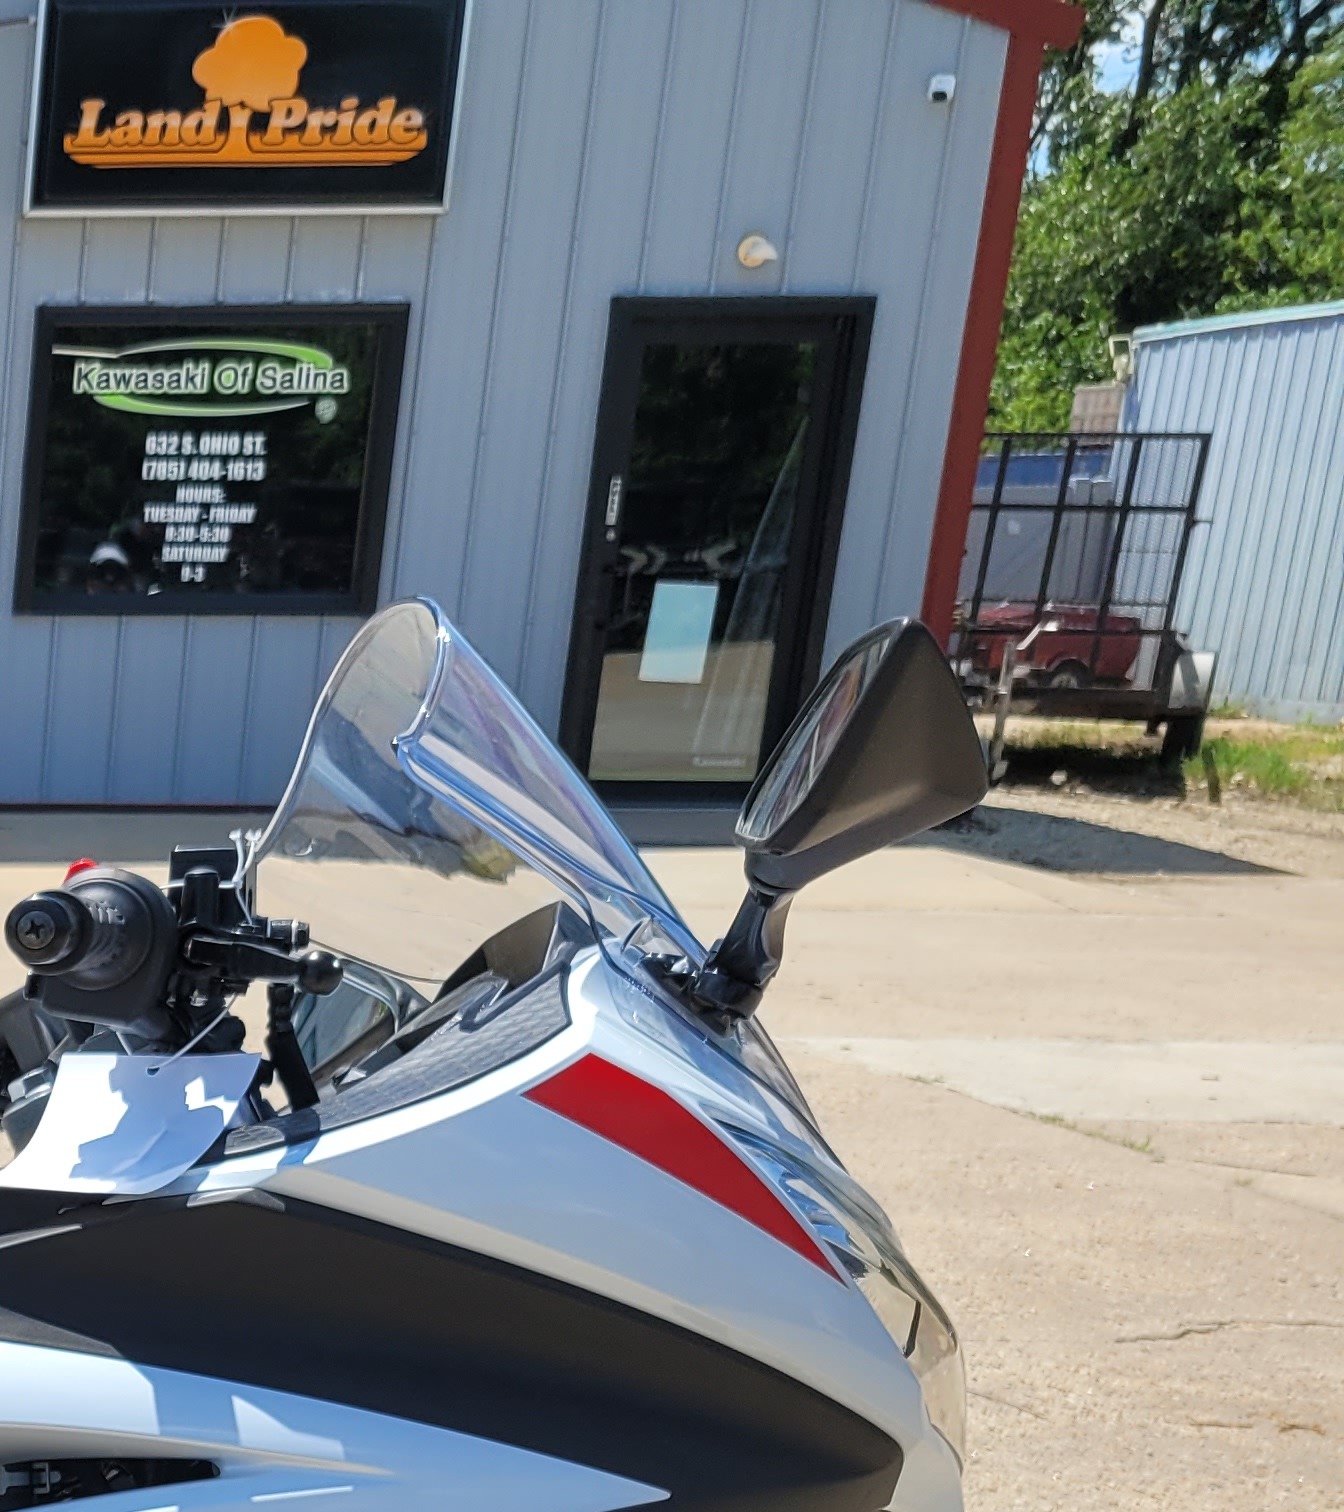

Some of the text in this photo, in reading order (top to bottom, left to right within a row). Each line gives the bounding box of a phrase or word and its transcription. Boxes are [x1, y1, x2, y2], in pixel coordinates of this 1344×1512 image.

[73, 96, 423, 148] Land Pride
[75, 361, 348, 392] Kawasaki Of Salina
[199, 432, 241, 455] OHIO
[143, 503, 201, 523] TUESDAY
[209, 503, 258, 523] FRIDAY
[162, 543, 229, 562] SATURDAY
